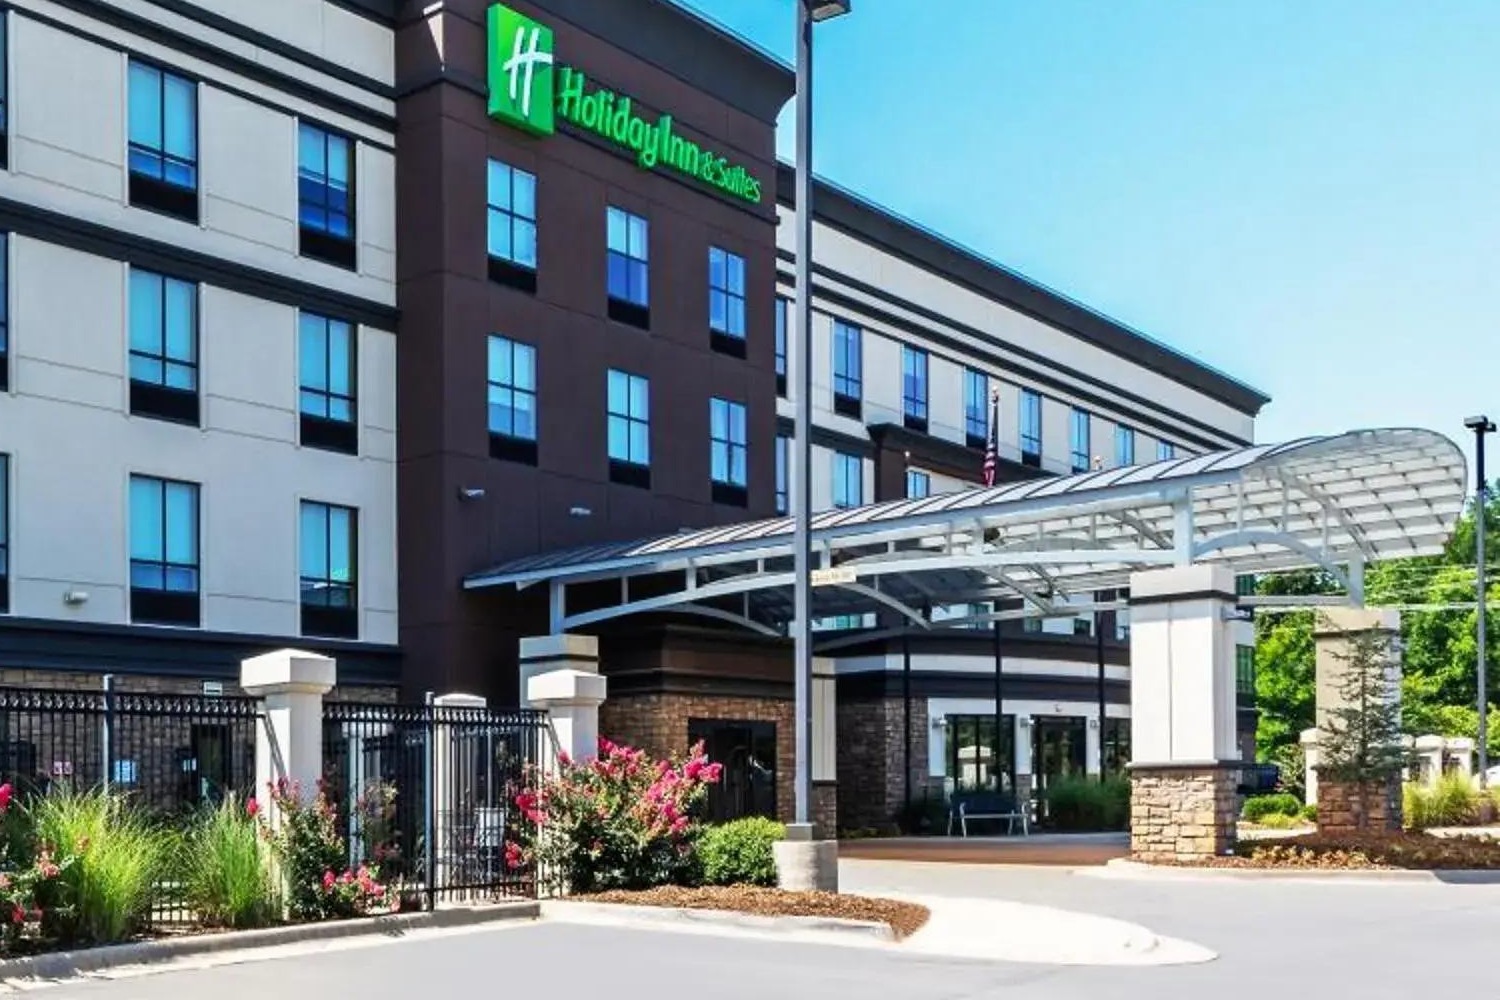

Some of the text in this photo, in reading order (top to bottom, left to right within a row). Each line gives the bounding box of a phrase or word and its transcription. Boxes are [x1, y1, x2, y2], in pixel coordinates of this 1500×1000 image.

[503, 27, 553, 117] H
[559, 67, 660, 168] Holiday
[660, 115, 699, 176] Inn
